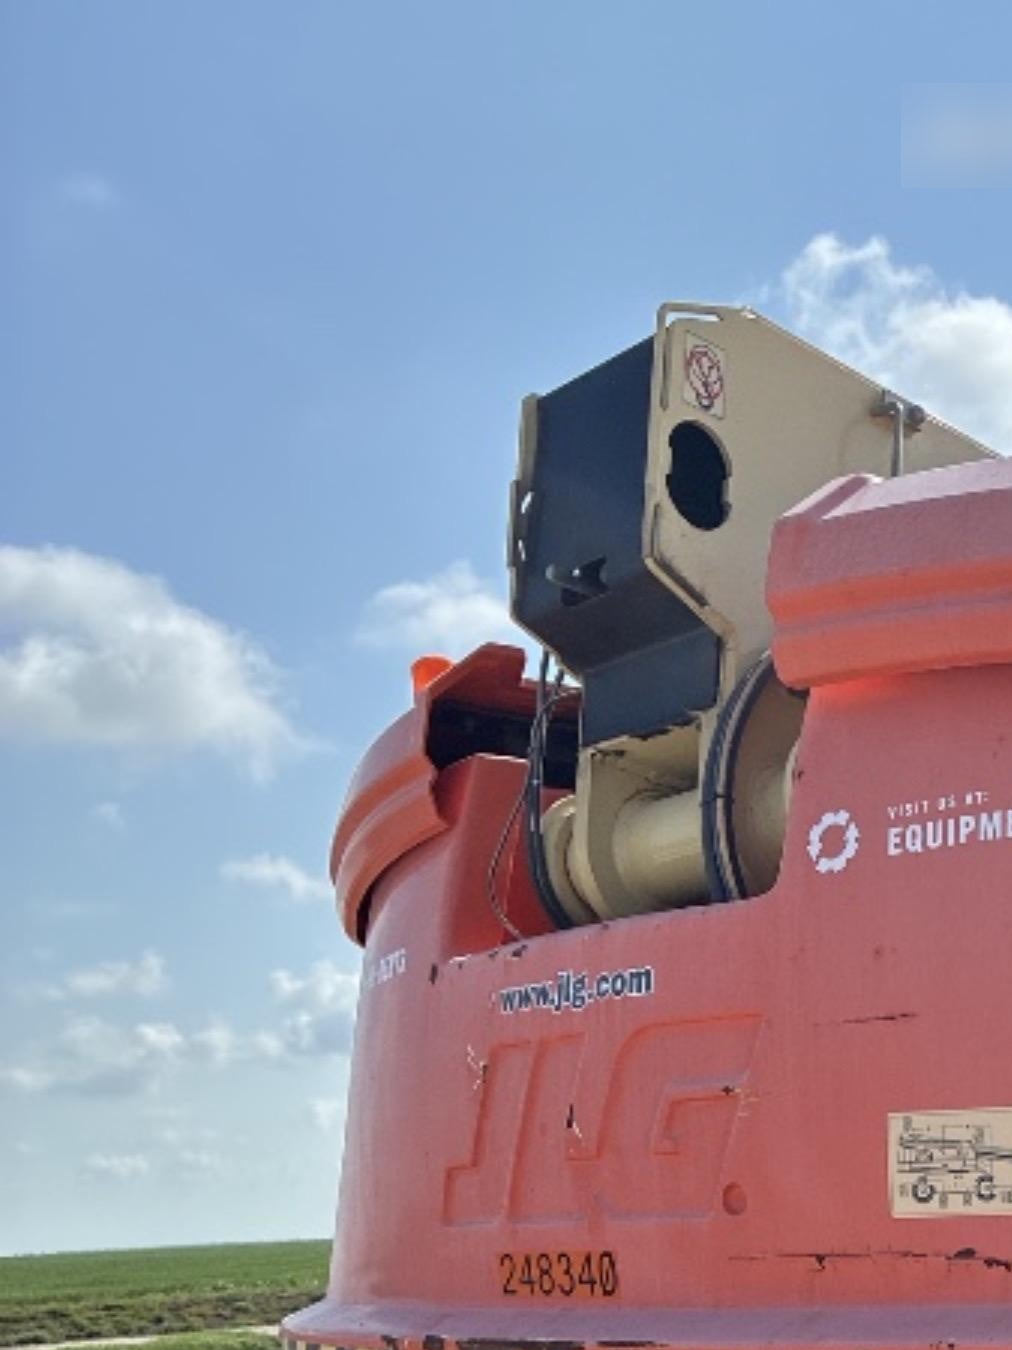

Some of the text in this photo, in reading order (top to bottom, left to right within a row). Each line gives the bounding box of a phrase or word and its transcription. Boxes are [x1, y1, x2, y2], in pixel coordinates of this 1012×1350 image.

[887, 800, 929, 820] VISIT
[500, 966, 655, 1014] www.jlg.com
[442, 1012, 766, 1227] JLG
[499, 1250, 618, 1297] 248340
